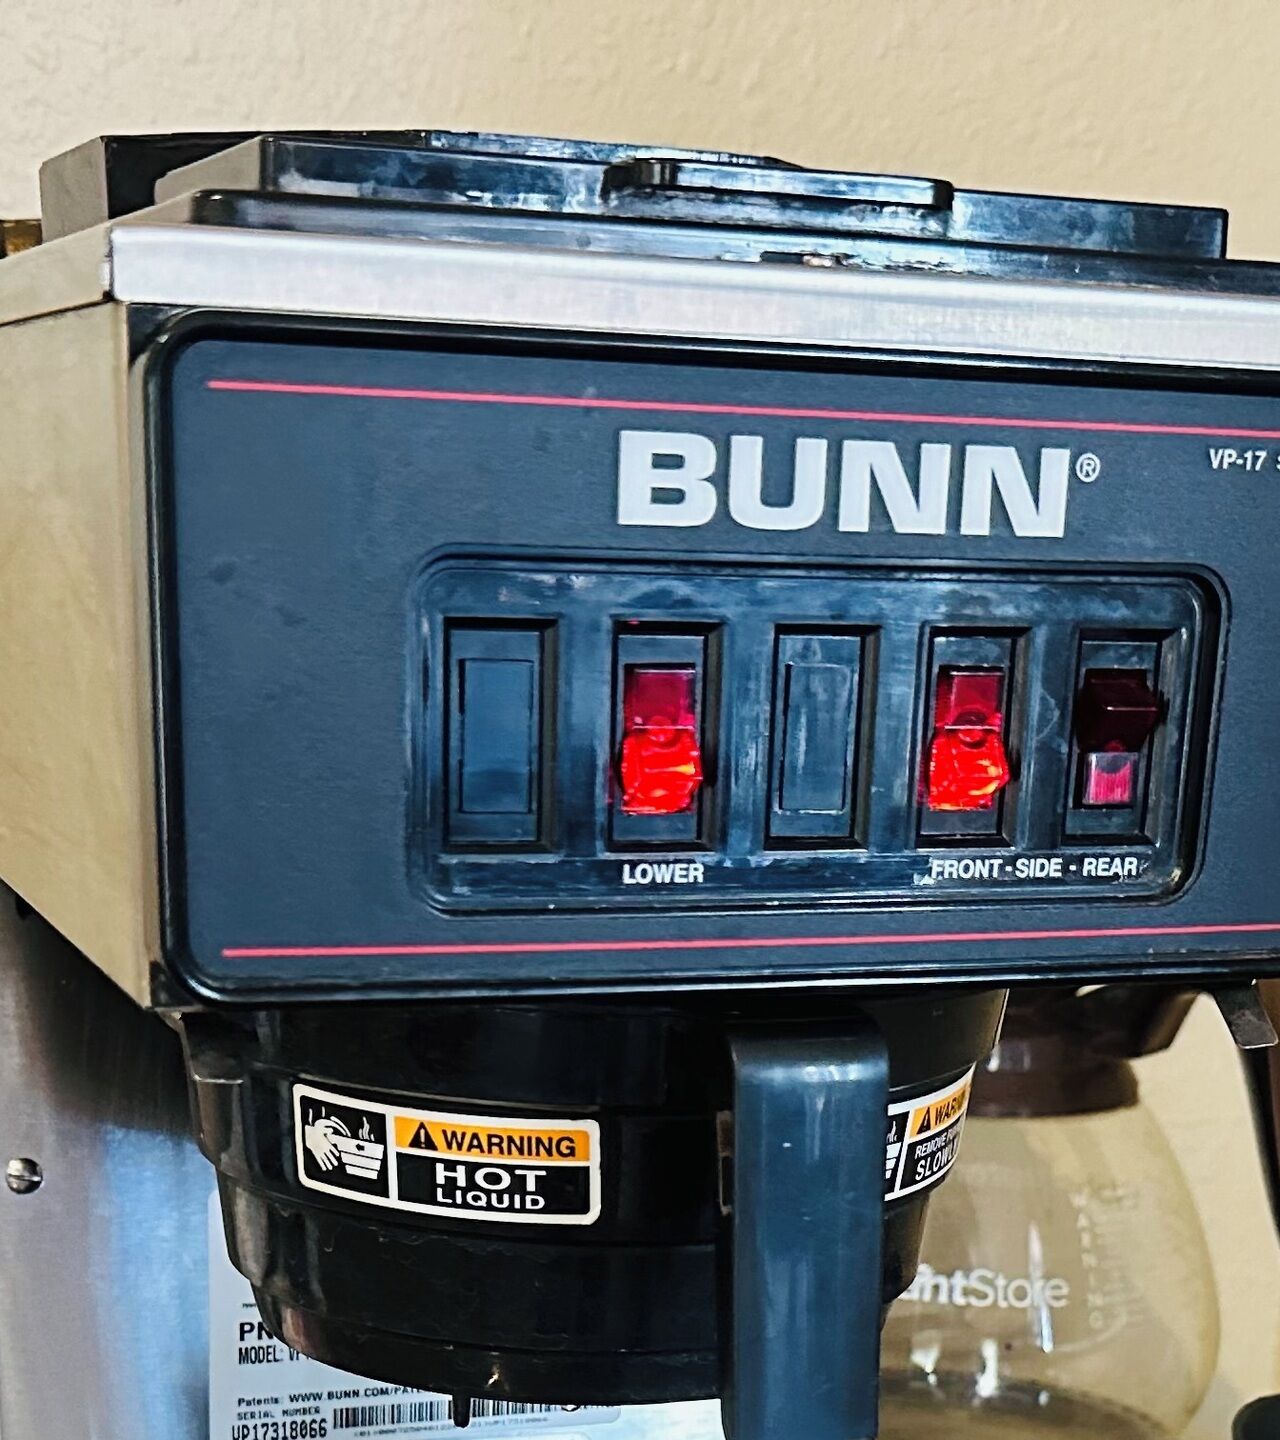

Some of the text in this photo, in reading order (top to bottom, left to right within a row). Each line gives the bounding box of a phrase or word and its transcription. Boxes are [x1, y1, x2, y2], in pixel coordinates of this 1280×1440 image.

[1208, 447, 1267, 473] VP-17
[622, 863, 705, 885] LOWER
[930, 858, 1003, 880] FRONT
[1014, 858, 1063, 879] SIDE
[1081, 856, 1138, 878] REAR
[441, 1128, 577, 1159] WARNING
[435, 1162, 548, 1193] HOT
[436, 1187, 546, 1211] LIQUID
[238, 1344, 284, 1365] MODEL:
[236, 1405, 320, 1421] SERIAL NUMBER
